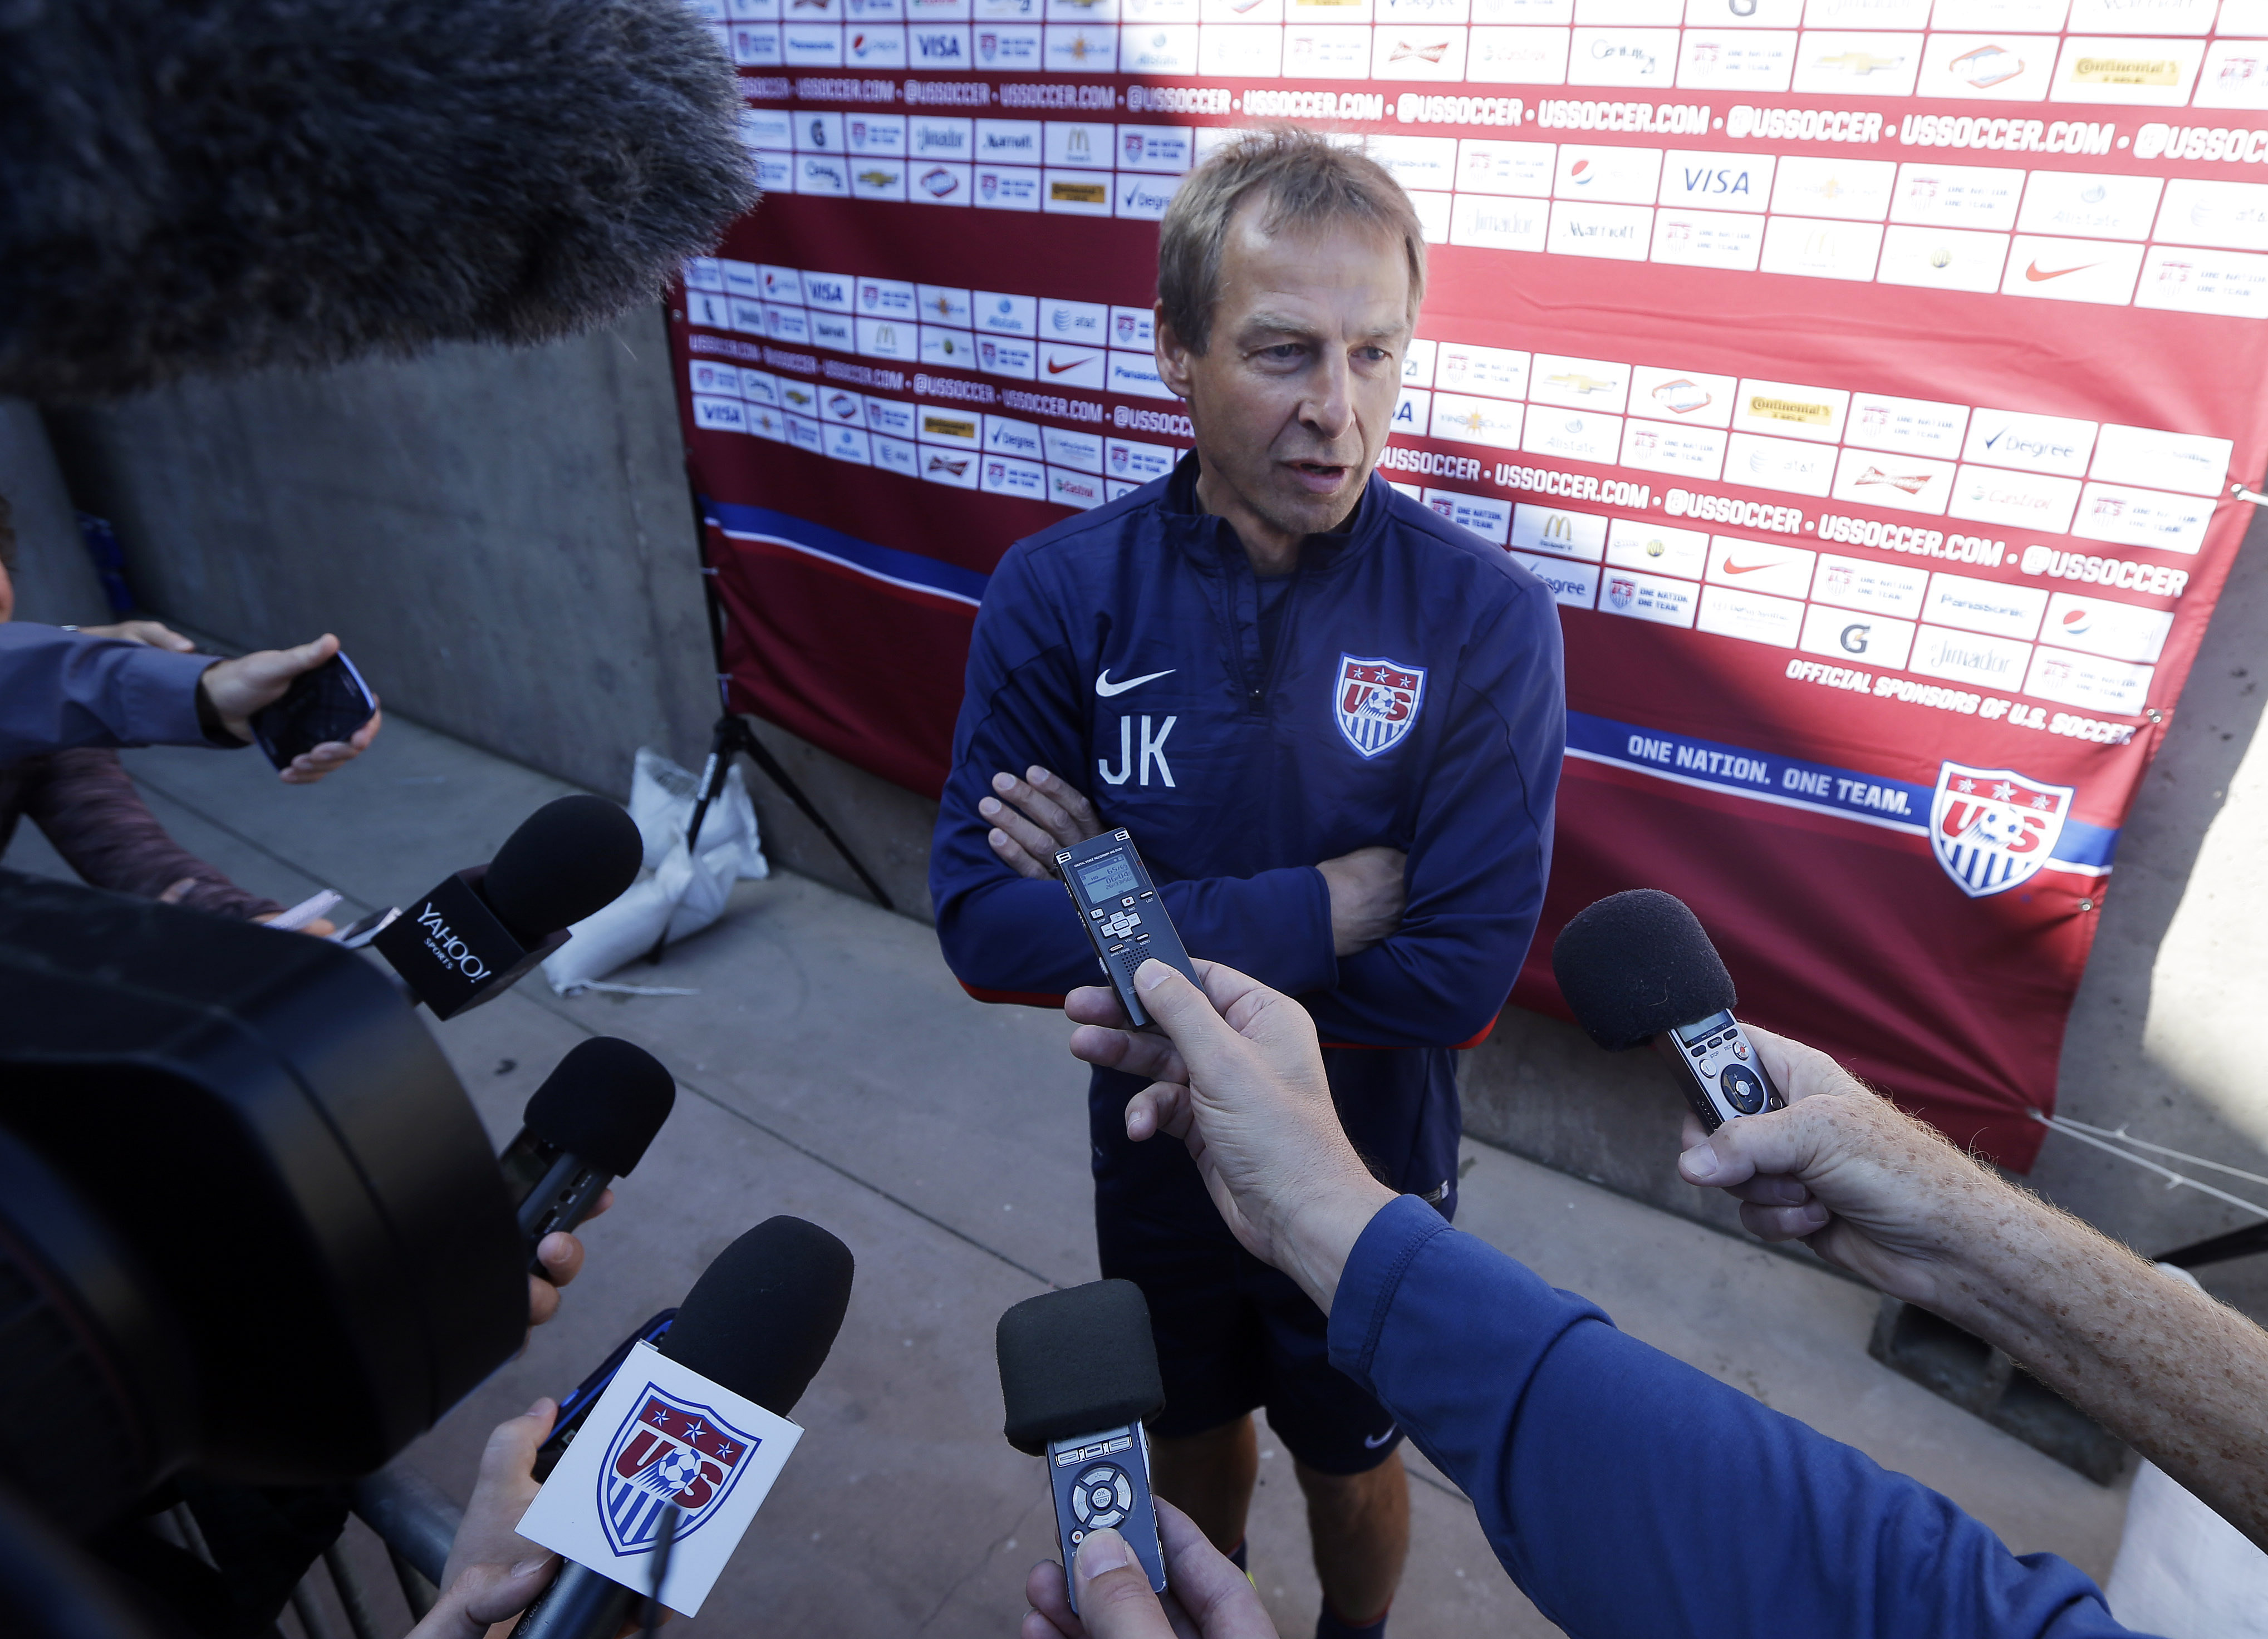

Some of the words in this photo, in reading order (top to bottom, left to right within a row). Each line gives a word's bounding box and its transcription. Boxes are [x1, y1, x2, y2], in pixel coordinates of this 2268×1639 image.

[917, 35, 960, 57] VISA
[1000, 83, 1115, 110] USSOCCER.COM
[1126, 85, 1231, 115] @USSOCCER
[1242, 90, 1384, 121] USSOCCER.COM
[1397, 92, 1523, 126] @USSOCCER
[1538, 99, 1711, 135] USSOCCER.COM
[1726, 105, 1883, 144] @USSOCCER
[1899, 114, 2115, 156] USSOCCER.COM
[2133, 122, 2268, 164] @USSOC
[1684, 168, 1750, 195] VISA
[809, 282, 843, 302] VISA
[914, 372, 995, 405] @USSOCCER
[1002, 388, 1104, 424] USSOCCER.COM
[1114, 405, 1196, 438] @USSOCC
[2005, 436, 2075, 458] Degree
[1456, 516, 1470, 525] ONE
[1457, 505, 1470, 514] ONE
[1495, 462, 1651, 510] USSOCCER.COM
[1663, 488, 1803, 534] @USSOCCER
[1818, 513, 2006, 568] USSOCCER.COM
[2020, 545, 2190, 598] @USSOCCER
[1638, 597, 1652, 607] ONE
[1639, 586, 1655, 598] ONE
[1839, 623, 1871, 654] G
[1342, 683, 1412, 722] US
[1785, 658, 1872, 695] OFFICIAL
[1872, 676, 1981, 715] SPONSORS
[1978, 696, 2012, 720] OF
[2007, 702, 2047, 731] U.S.
[2048, 712, 2137, 746] SOCCER
[1098, 715, 1177, 788] JK
[1628, 734, 1672, 764] ONE
[1675, 745, 1771, 786] NATION.
[1783, 767, 1830, 798] ONE
[1837, 777, 1912, 816] TEAM.
[1093, 852, 1110, 860] RECORDER
[417, 902, 492, 984] YAHOO!
[424, 937, 454, 971] SPORTS
[615, 1429, 724, 1509] US
[1095, 1496, 1110, 1504] MENU
